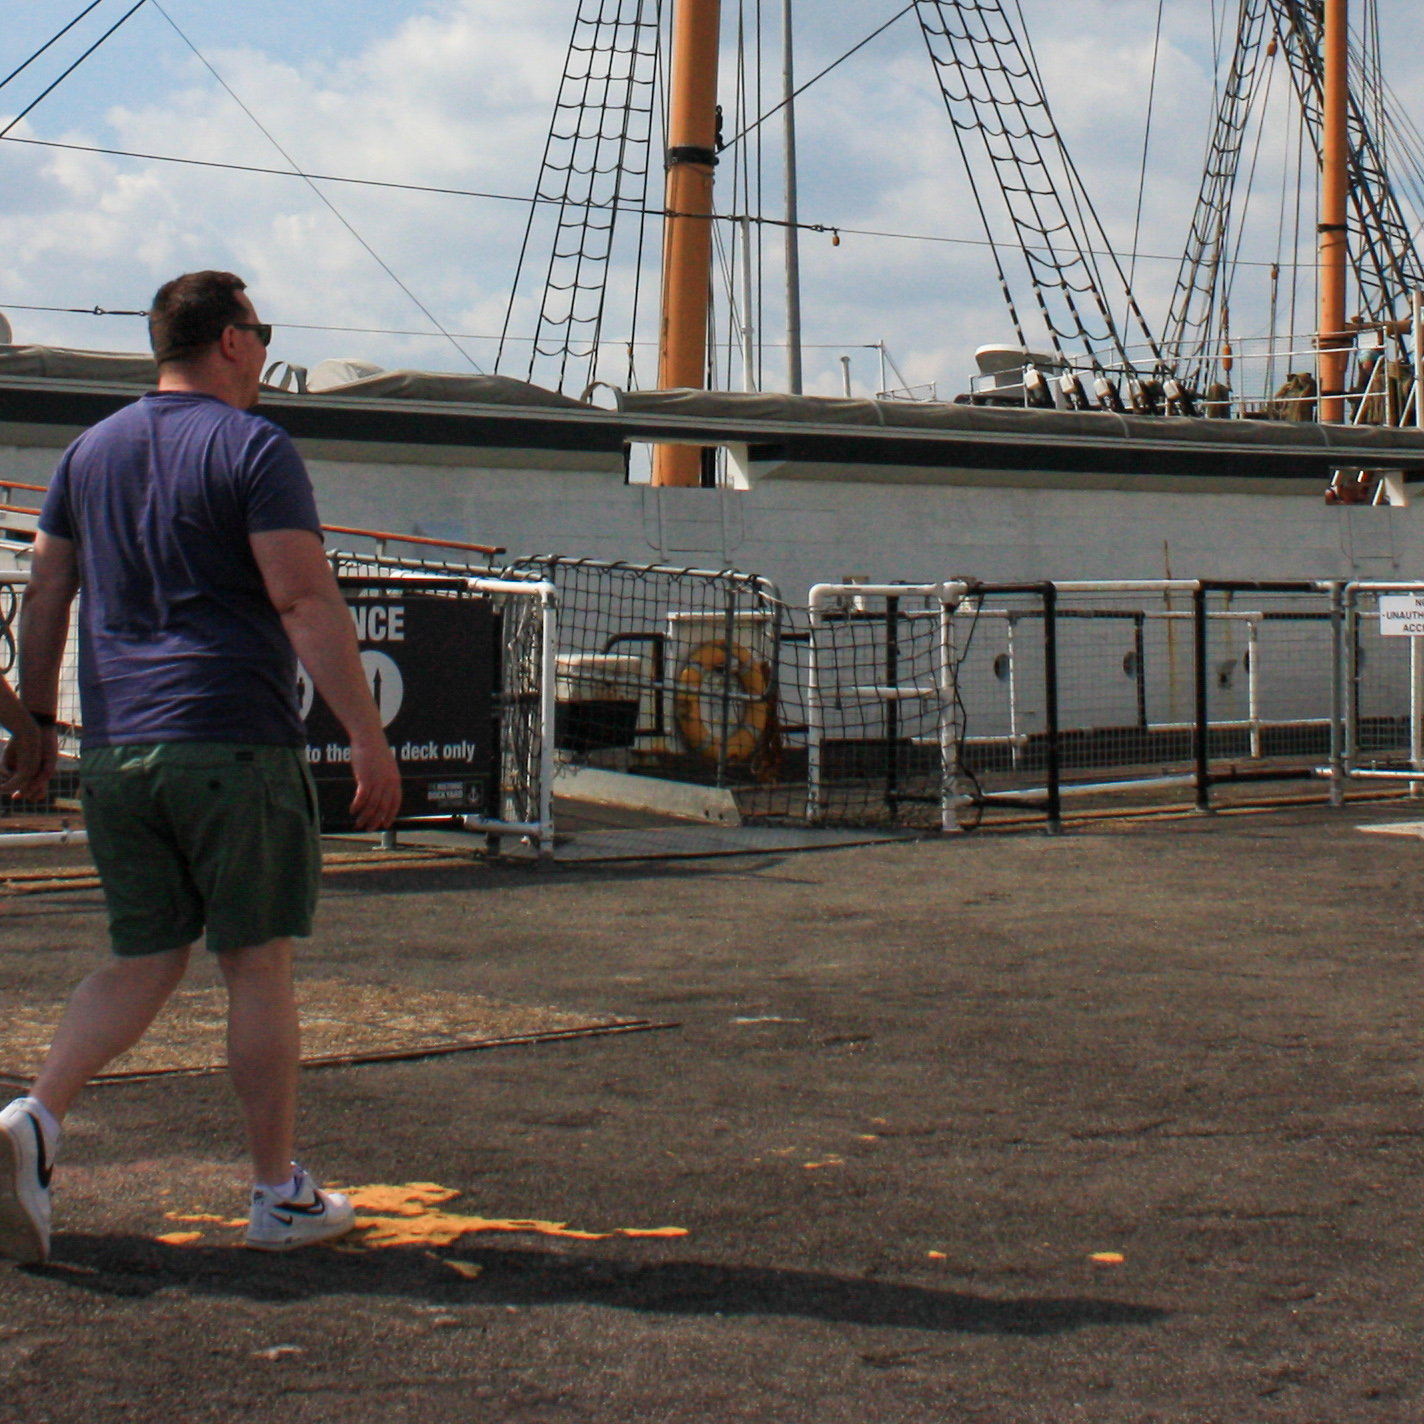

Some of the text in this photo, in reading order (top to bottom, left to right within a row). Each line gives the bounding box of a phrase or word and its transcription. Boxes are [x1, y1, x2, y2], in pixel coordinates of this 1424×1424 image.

[326, 742, 351, 762] the
[401, 740, 438, 761] deck
[443, 739, 475, 763] only
